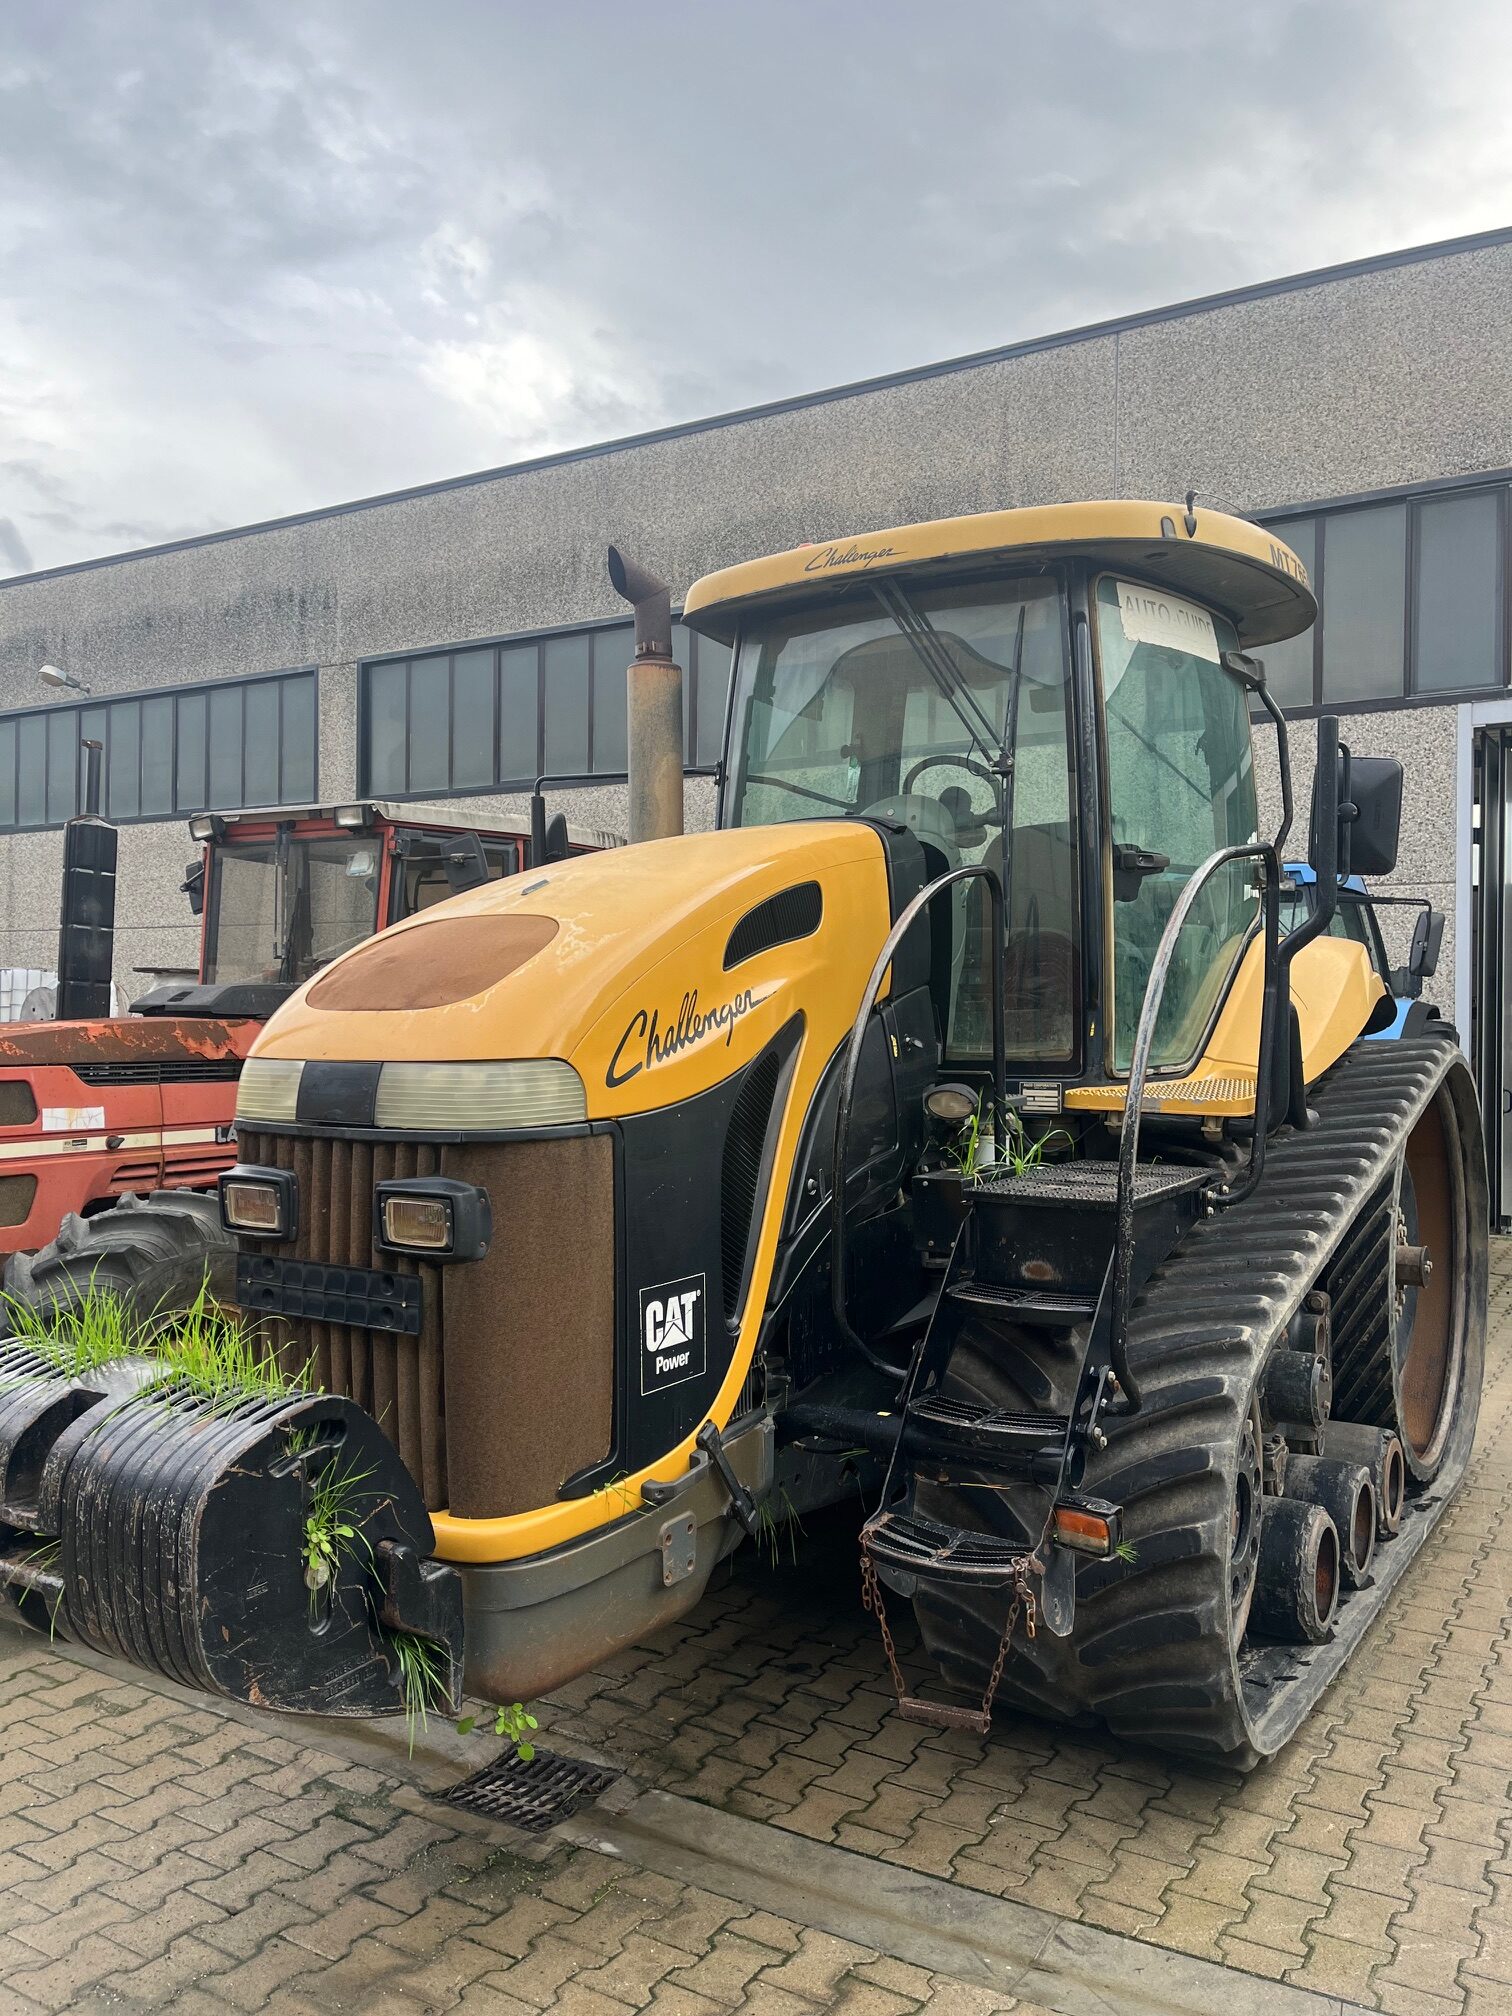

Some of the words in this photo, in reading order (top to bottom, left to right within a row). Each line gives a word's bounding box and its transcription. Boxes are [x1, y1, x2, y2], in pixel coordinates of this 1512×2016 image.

[804, 545, 908, 571] Challenger
[605, 988, 778, 1088] Challenger
[217, 1125, 239, 1143] LA
[645, 1290, 697, 1353] CAT
[655, 1351, 690, 1375] Power
